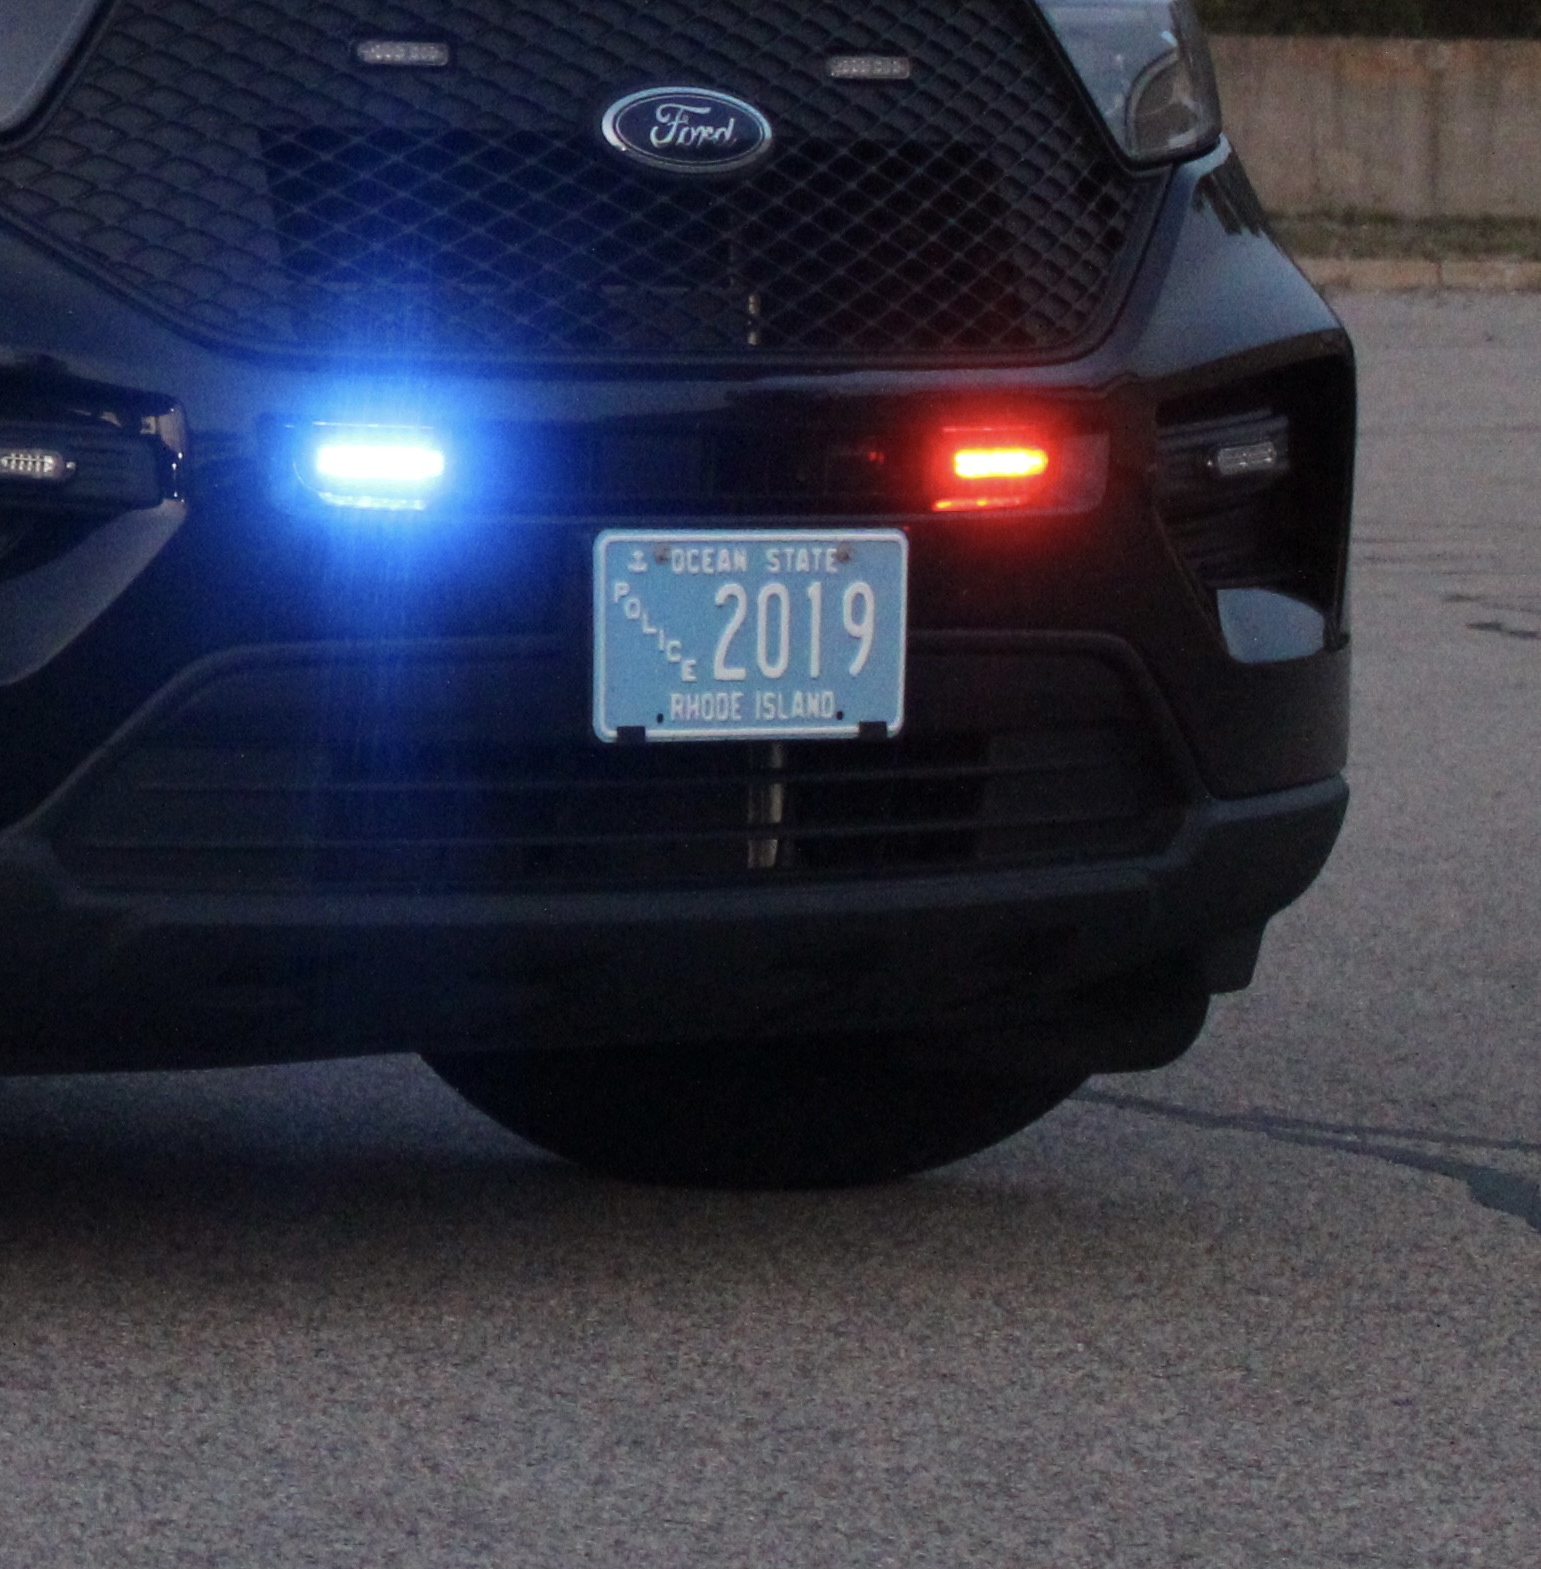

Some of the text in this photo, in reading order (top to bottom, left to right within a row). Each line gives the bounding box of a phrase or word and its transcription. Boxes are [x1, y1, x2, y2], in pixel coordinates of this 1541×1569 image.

[650, 103, 737, 148] Ford
[671, 547, 838, 574] OCEAN STATE
[615, 582, 697, 682] POLICE
[713, 581, 875, 681] 2019
[670, 690, 837, 720] RHODE ISLAND
